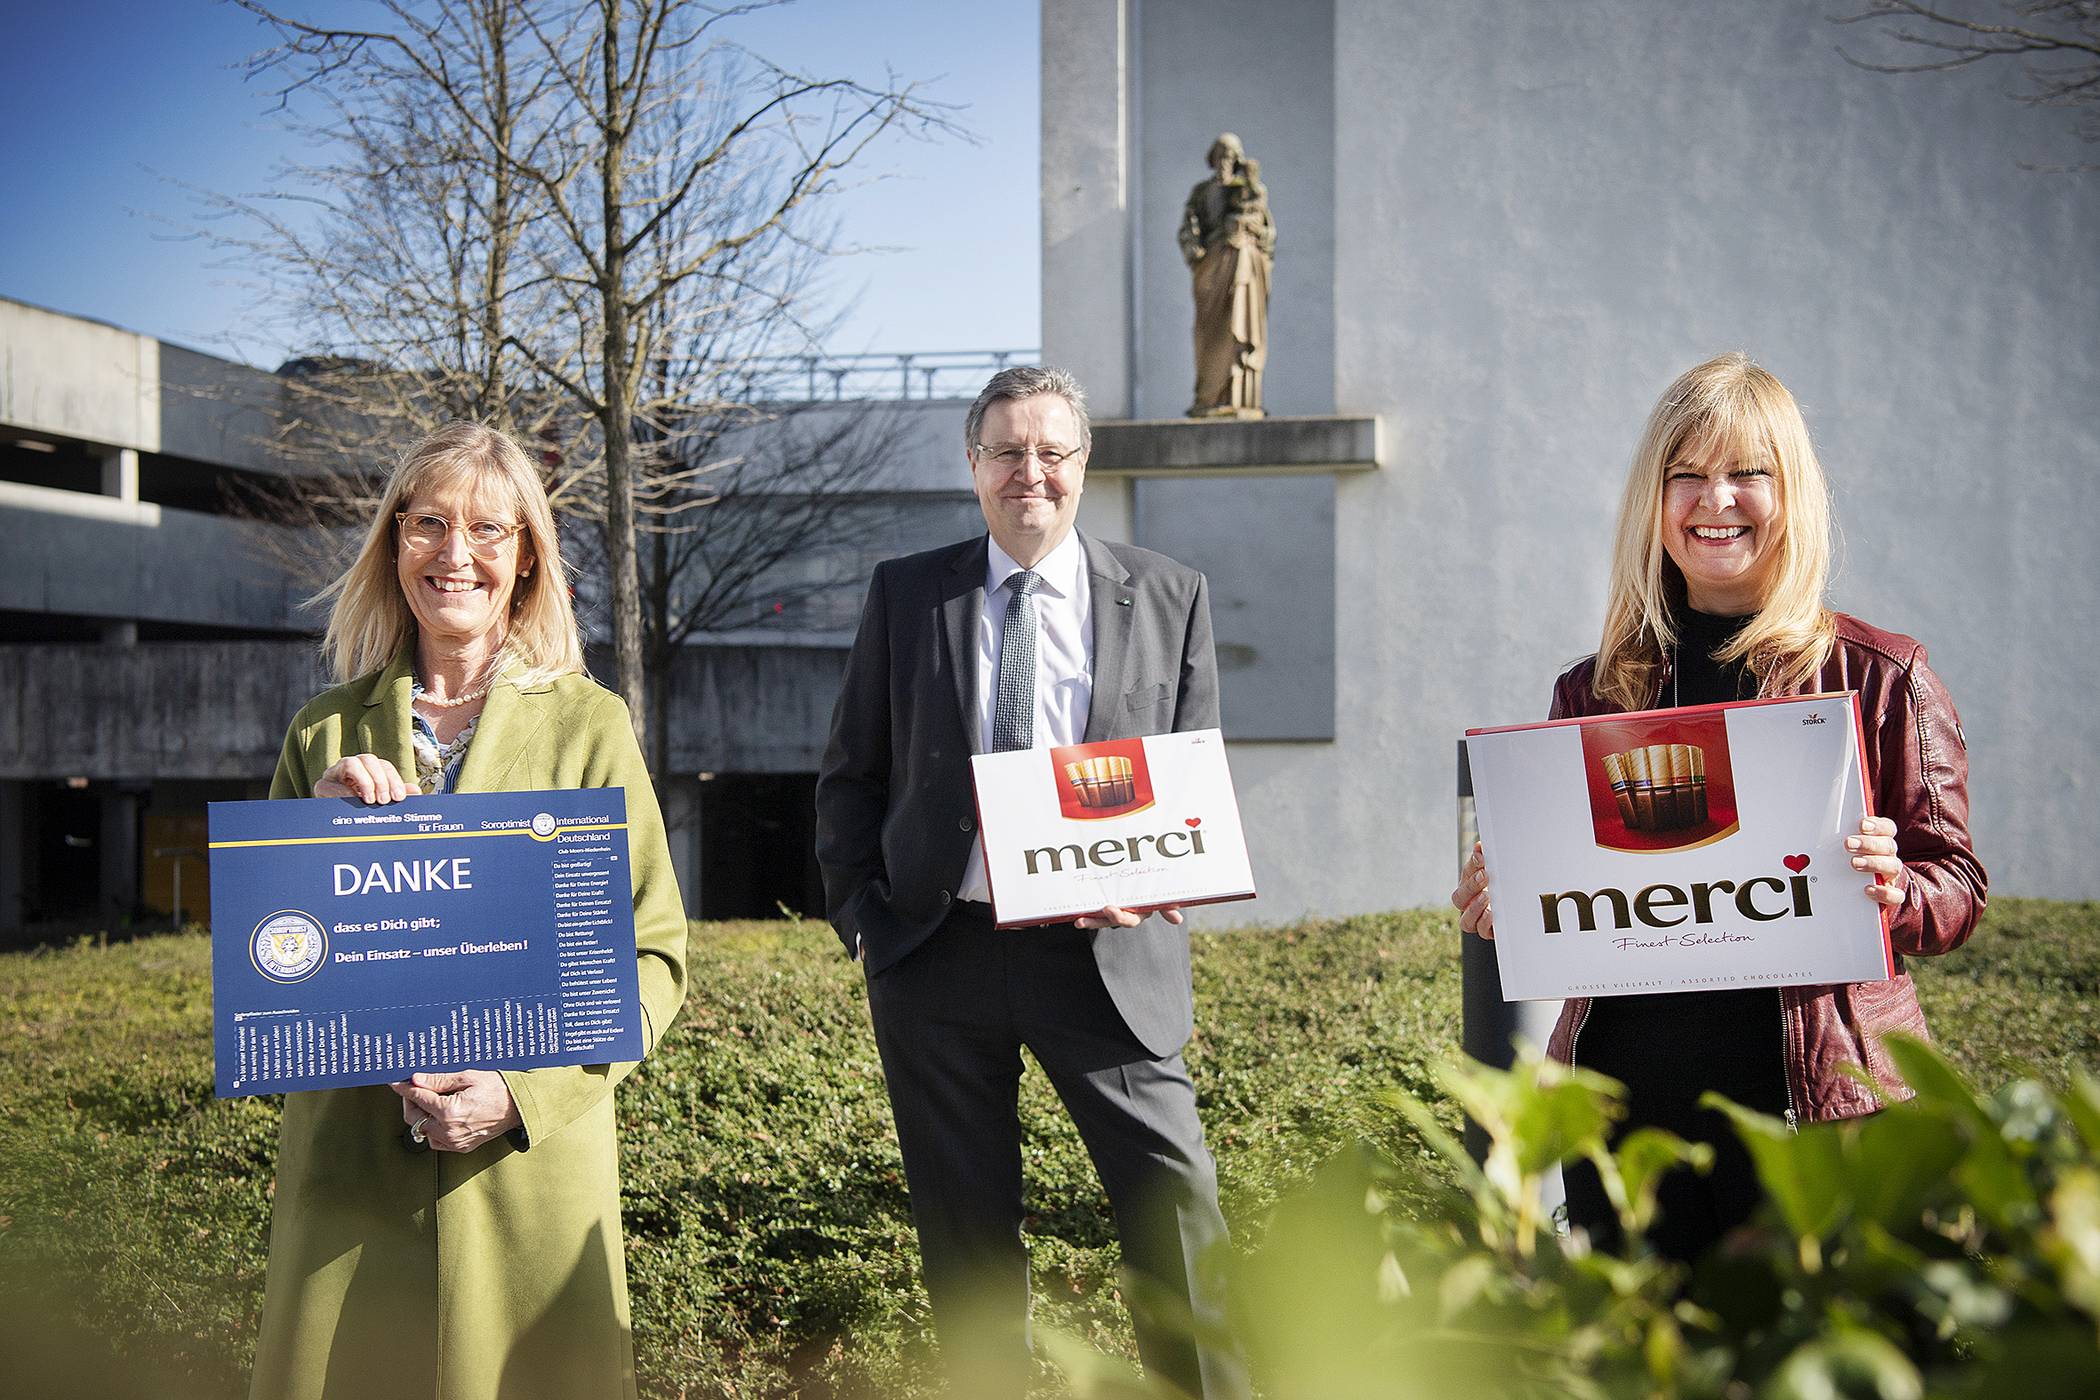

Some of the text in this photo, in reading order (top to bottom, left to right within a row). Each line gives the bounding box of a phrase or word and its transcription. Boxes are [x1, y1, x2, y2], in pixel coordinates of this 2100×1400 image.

[1802, 718, 1826, 726] STORCK
[332, 813, 442, 825] eine weltweite Stimme
[418, 822, 464, 832] für Frauen
[481, 819, 531, 830] Soroptimist
[556, 815, 609, 826] International
[558, 832, 610, 843] Deutschland
[1024, 817, 1205, 875] merci
[334, 858, 472, 896] DANKE
[1538, 854, 1813, 934] merci
[334, 917, 440, 933] dass es Dich gibt;
[1612, 931, 1755, 951] Finest Selection
[335, 951, 364, 963] Dein
[367, 949, 411, 960] Einsatz
[423, 947, 458, 957] unser
[1613, 980, 1663, 989] VIELFALT
[1681, 975, 1736, 984] ASSORTED
[1743, 971, 1814, 981] CHOCOLATES
